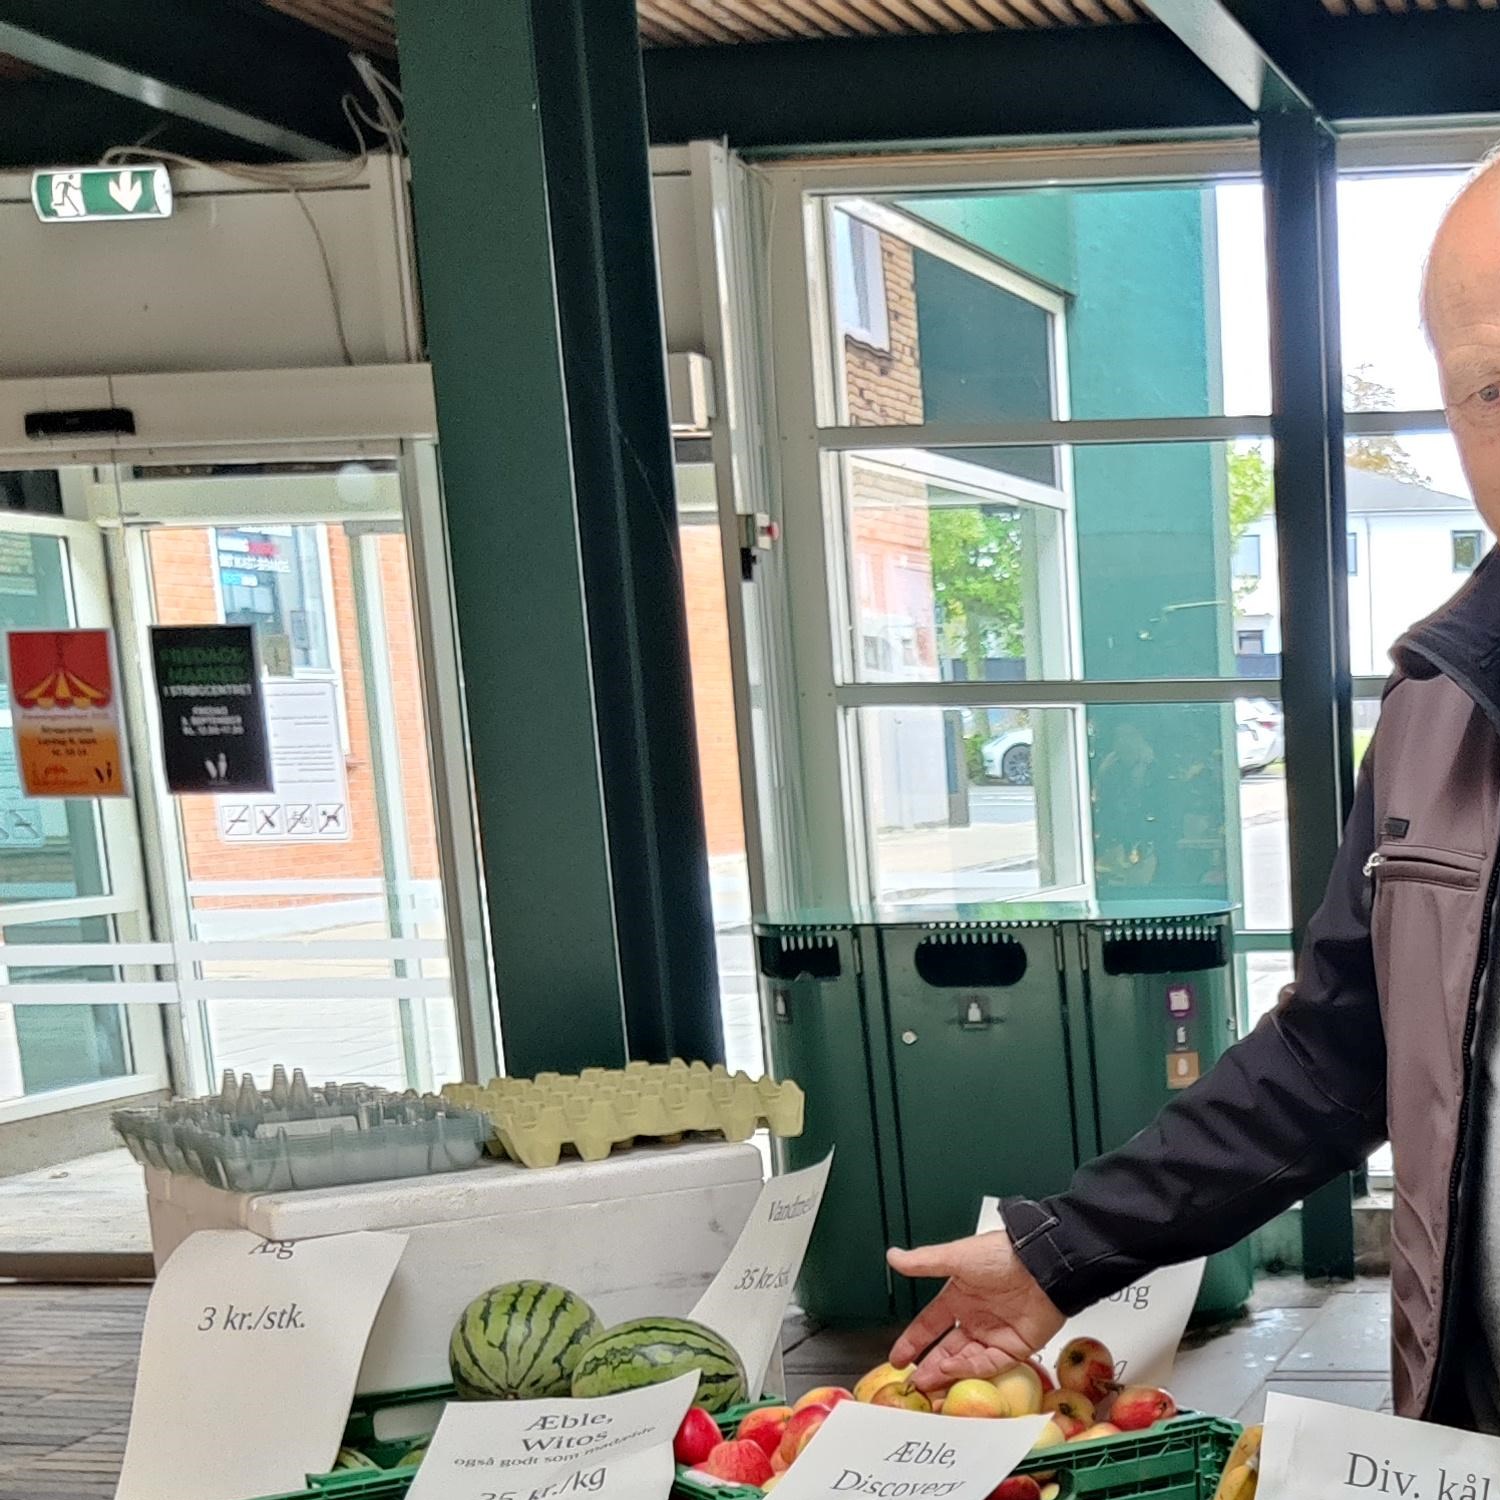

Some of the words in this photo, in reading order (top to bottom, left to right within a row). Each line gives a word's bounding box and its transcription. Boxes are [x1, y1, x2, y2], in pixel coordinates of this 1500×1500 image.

[733, 1268, 759, 1290] 35
[197, 1305, 218, 1331] 3
[222, 1302, 306, 1331] kr./stk.
[524, 1412, 614, 1432] Æble,
[520, 1430, 609, 1452] Witos
[454, 1457, 495, 1468] også
[499, 1456, 539, 1468] godt
[543, 1452, 580, 1463] som
[883, 1441, 957, 1469] Æble,
[830, 1468, 967, 1498] Discovery
[1343, 1451, 1420, 1500] Div.
